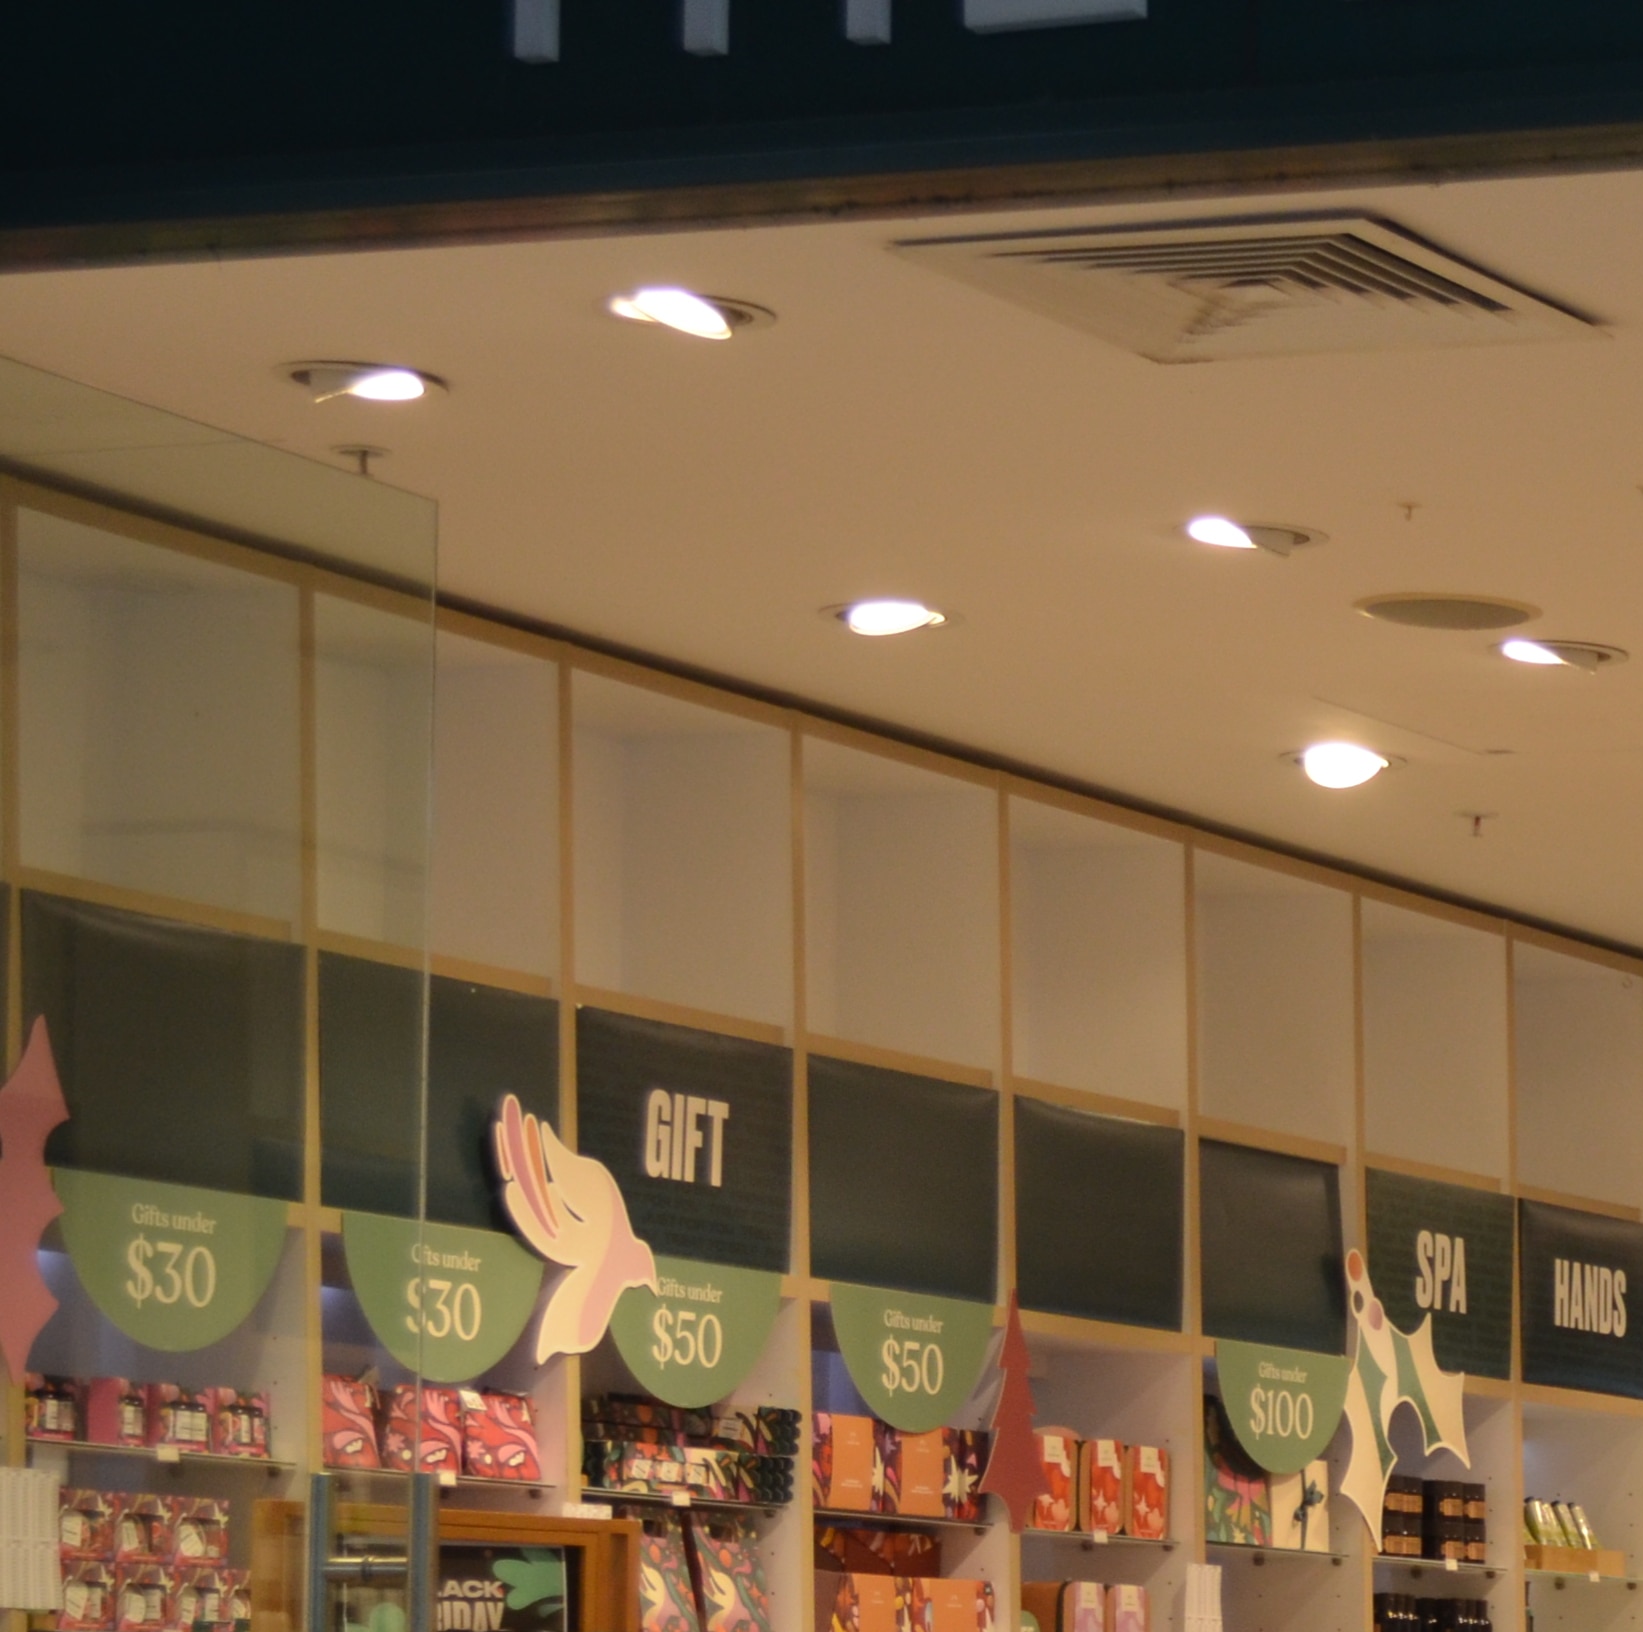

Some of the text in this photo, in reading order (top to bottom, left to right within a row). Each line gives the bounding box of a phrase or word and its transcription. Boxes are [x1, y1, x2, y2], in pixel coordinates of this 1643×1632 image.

[645, 1089, 729, 1187] GIFT
[132, 1203, 217, 1234] Gifts under
[126, 1233, 216, 1309] $30
[451, 1249, 482, 1273] under
[657, 1277, 723, 1304] Gifts under
[1416, 1230, 1467, 1314] SPA
[406, 1278, 482, 1341] $30
[884, 1310, 943, 1335] Gifts under
[1555, 1258, 1626, 1338] HANDS
[651, 1307, 723, 1369] $50
[881, 1337, 944, 1396] $50
[1258, 1362, 1307, 1385] Gifts under
[1250, 1389, 1314, 1440] $100
